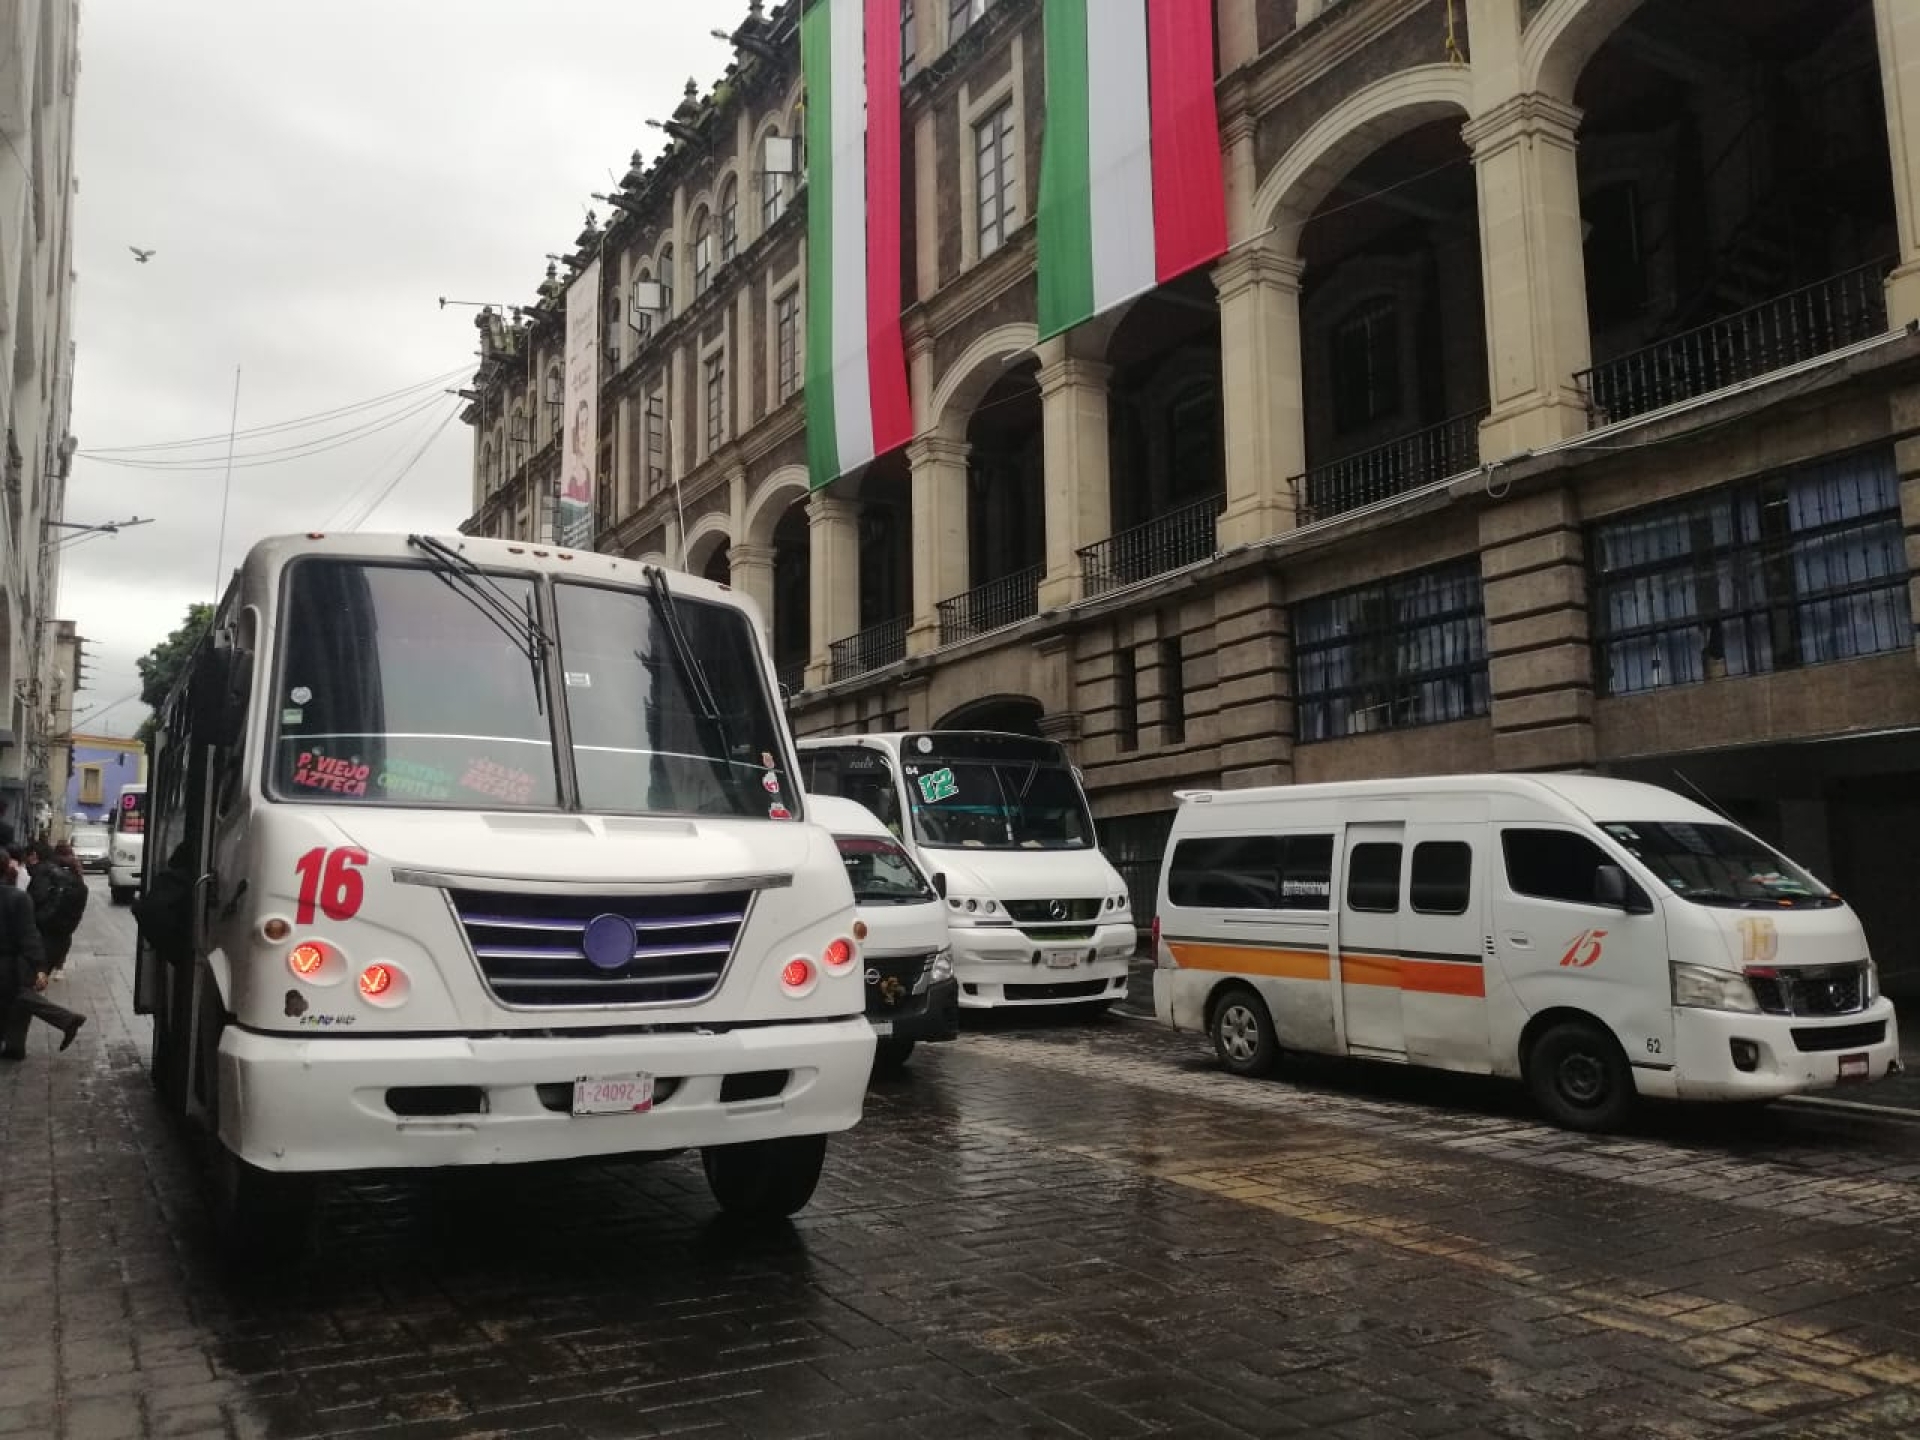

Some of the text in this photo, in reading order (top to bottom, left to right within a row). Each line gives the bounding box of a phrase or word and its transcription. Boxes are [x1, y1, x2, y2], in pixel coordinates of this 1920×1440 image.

[293, 769, 366, 797] AZTECA
[316, 755, 370, 781] VIEJO
[918, 767, 959, 803] 12
[295, 846, 369, 925] 16
[1559, 928, 1609, 967] 15
